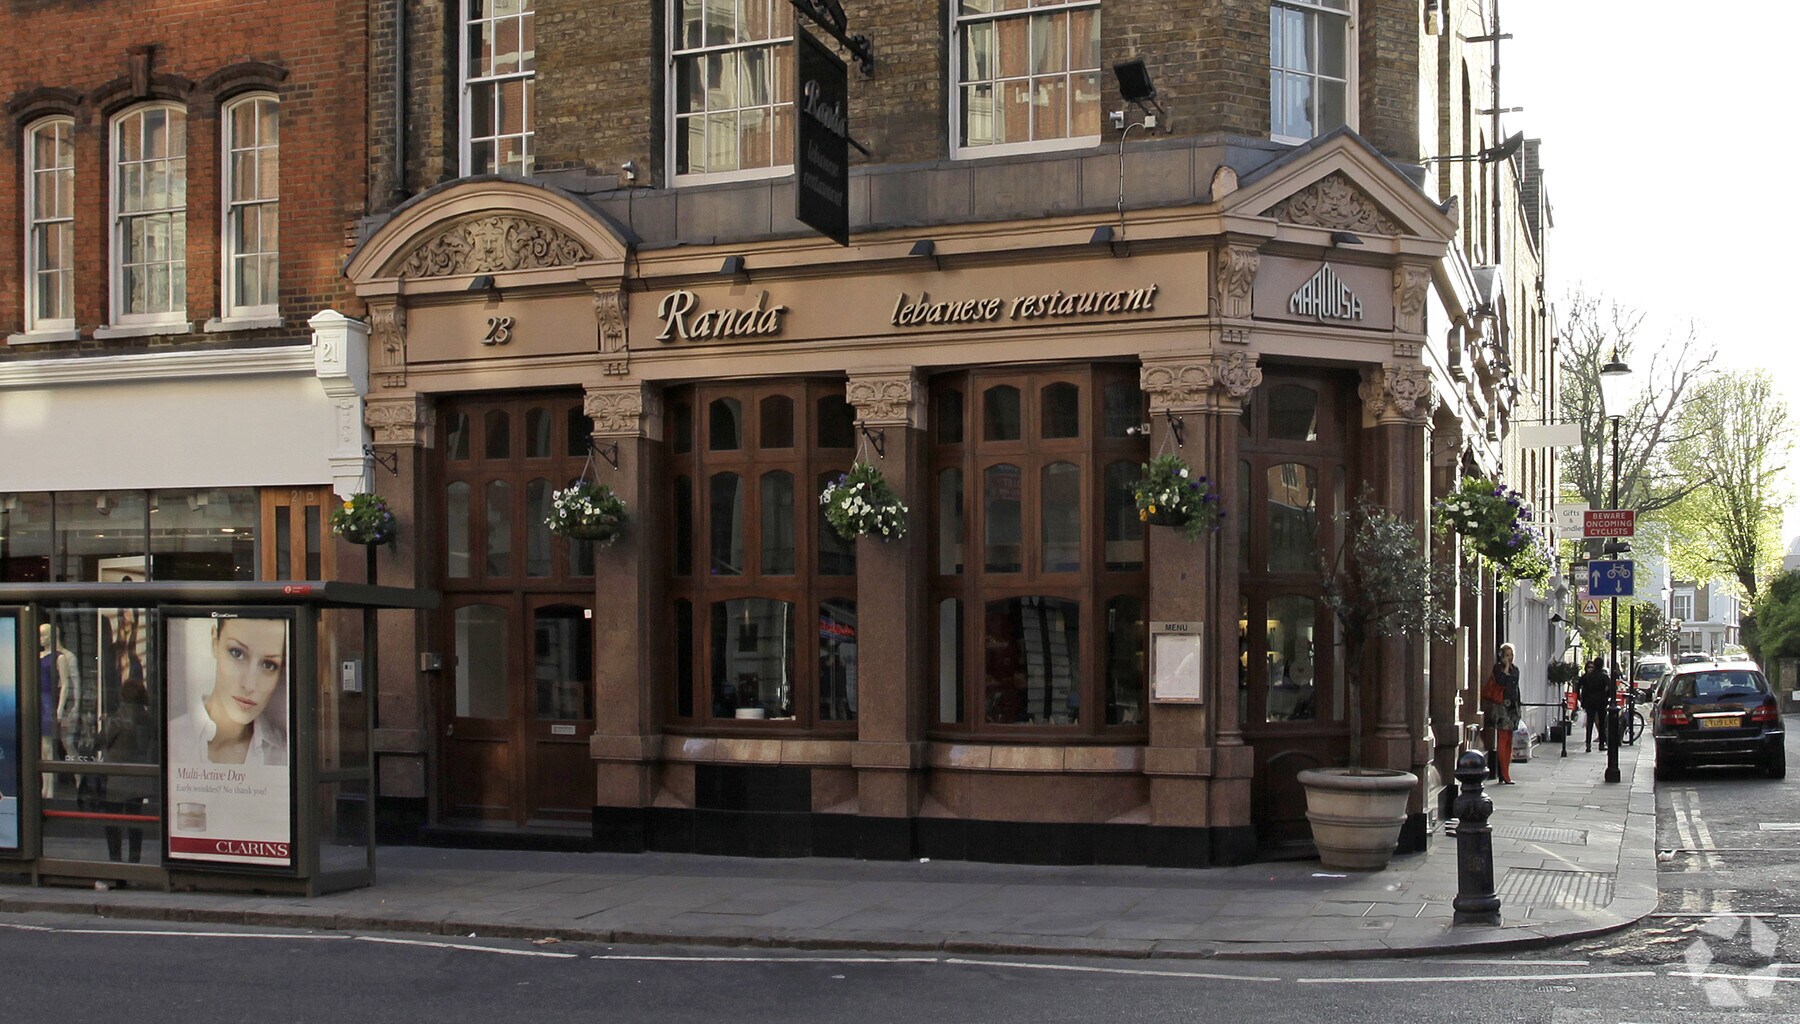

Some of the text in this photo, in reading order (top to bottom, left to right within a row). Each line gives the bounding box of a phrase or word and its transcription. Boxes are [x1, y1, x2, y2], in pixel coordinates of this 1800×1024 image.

[891, 283, 1159, 325] lebanese restaurant
[655, 289, 789, 340] Randa
[481, 316, 515, 345] 23
[323, 342, 338, 363] 21
[1586, 520, 1632, 528] ONCOMING
[1592, 512, 1626, 520] BEWARE
[1590, 528, 1628, 536] CYCLISTS
[1165, 624, 1188, 632] MENU
[177, 768, 247, 784] Multi-Active Day
[176, 784, 192, 793] Early
[223, 786, 233, 794] No
[234, 786, 252, 794] thank
[216, 841, 288, 857] CLARINS
